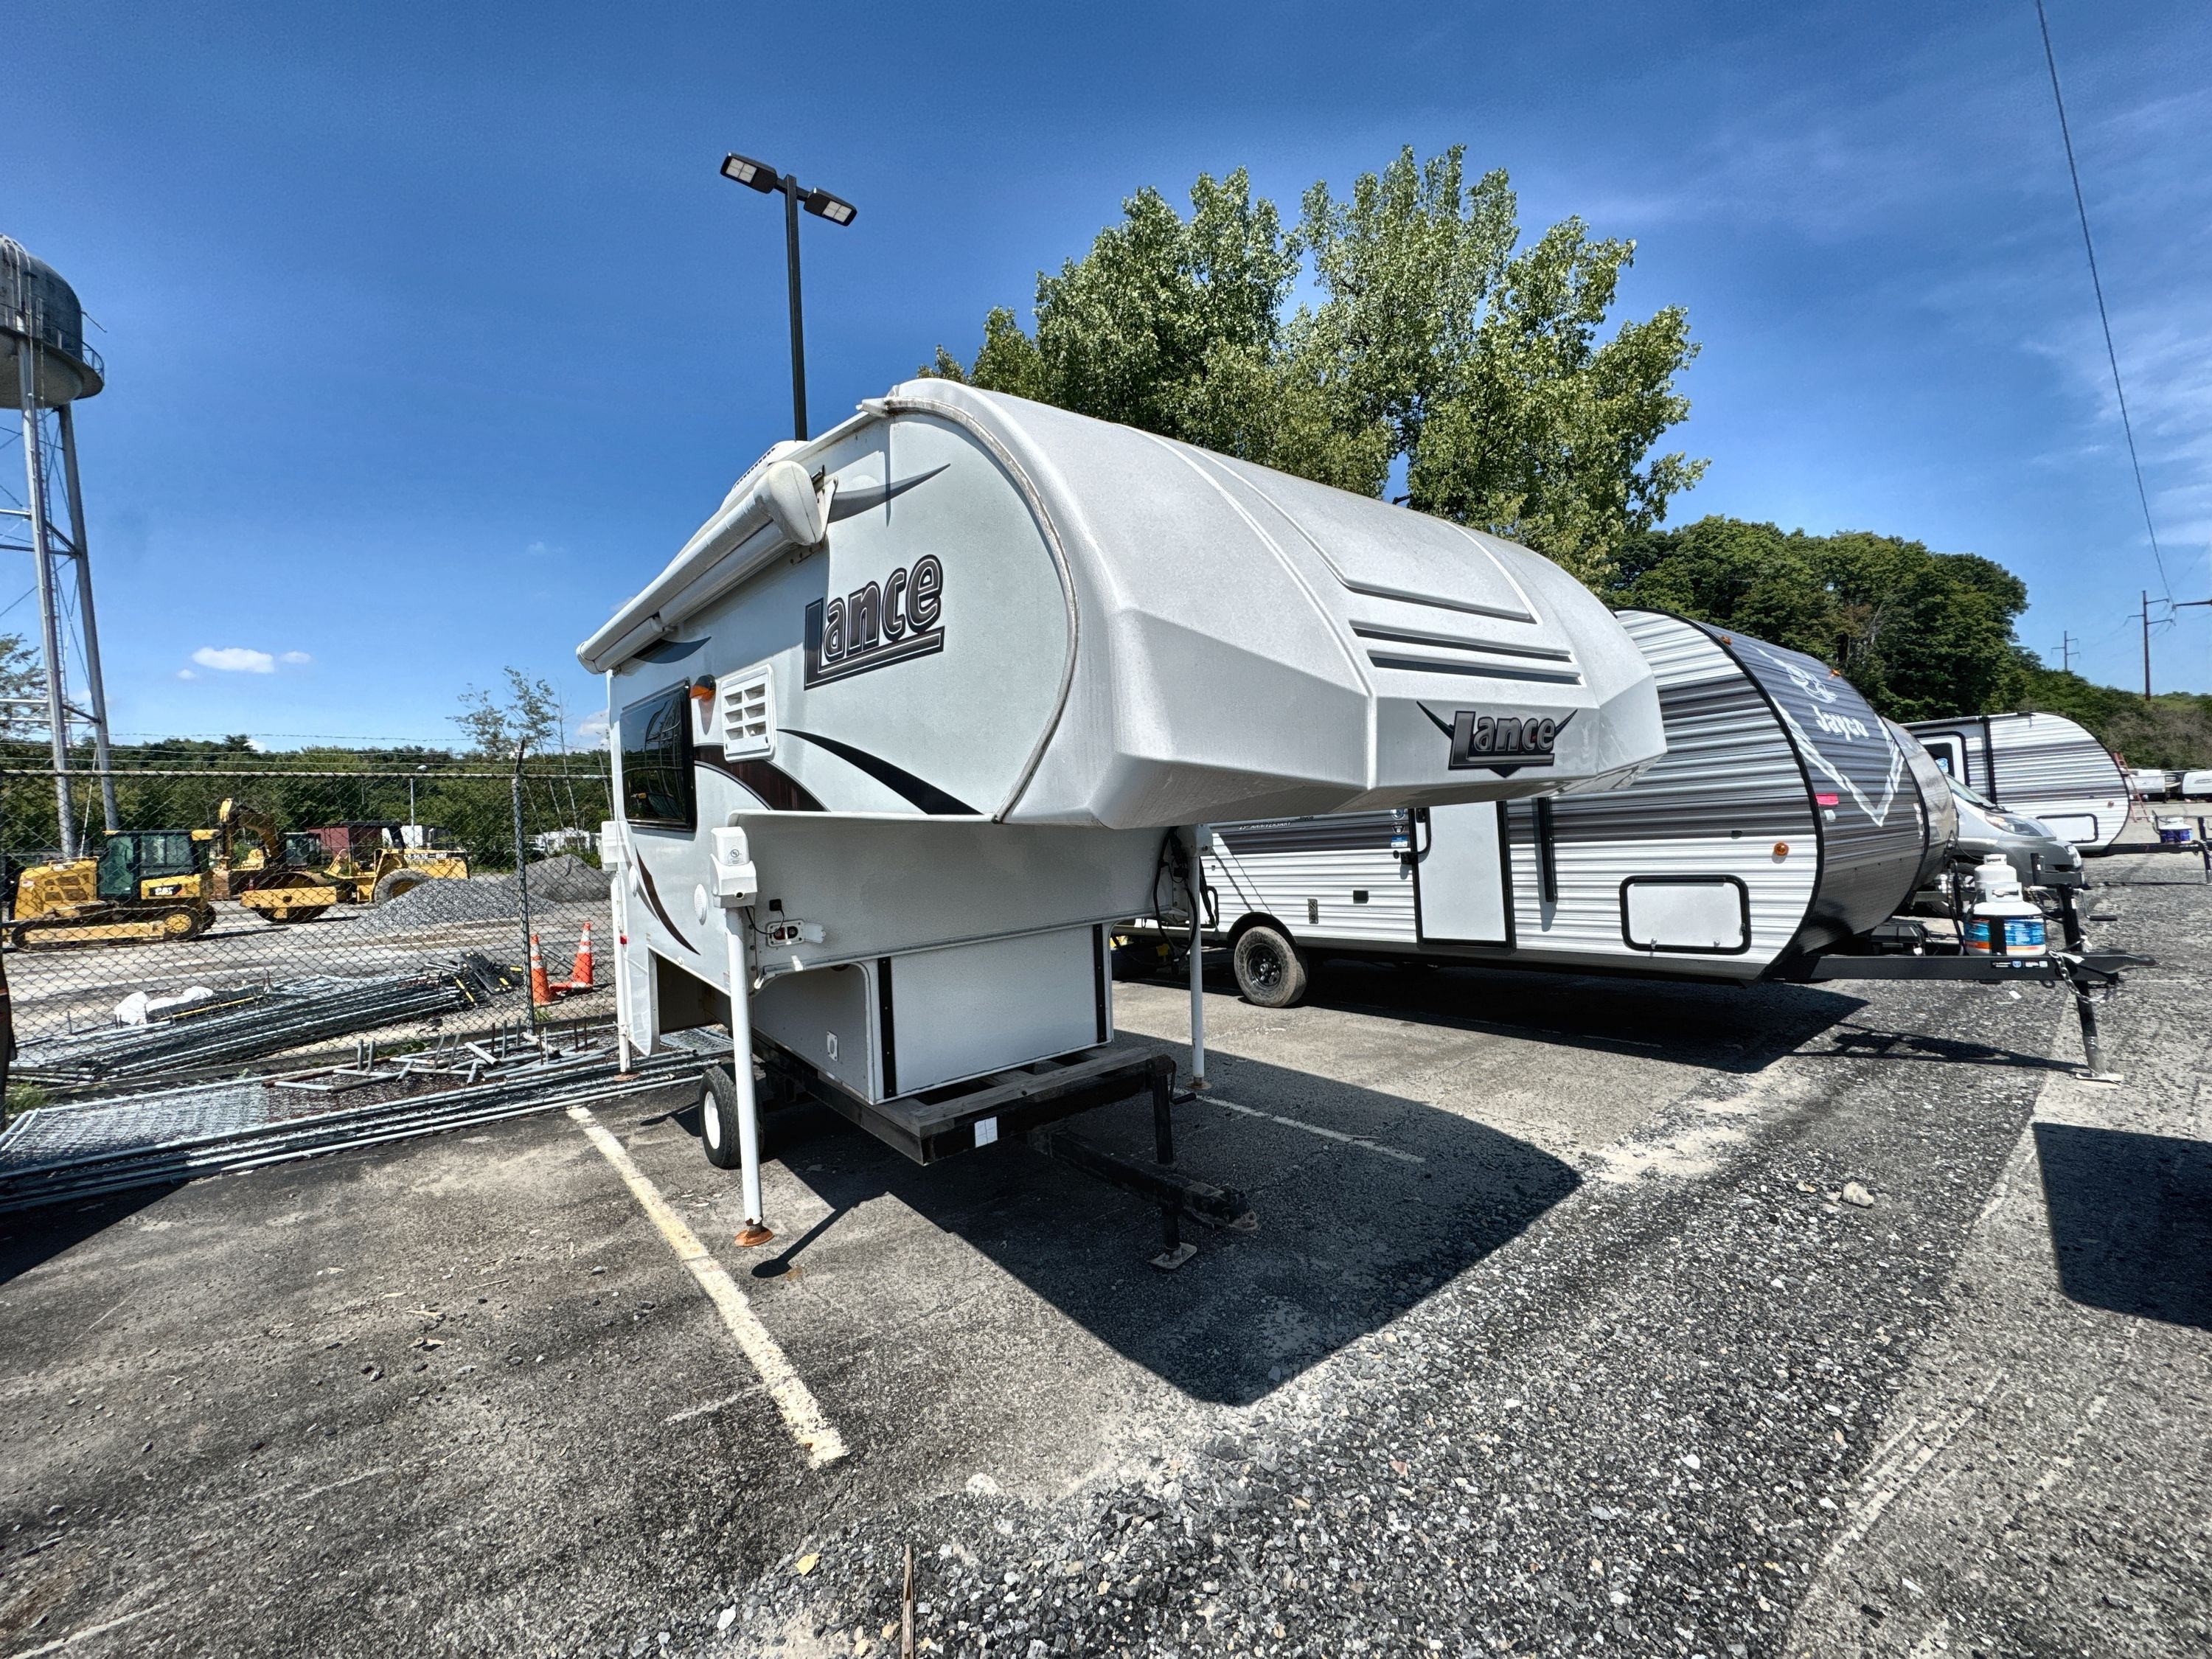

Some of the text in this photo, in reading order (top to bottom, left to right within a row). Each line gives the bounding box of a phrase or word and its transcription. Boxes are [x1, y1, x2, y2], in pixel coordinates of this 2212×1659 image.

[804, 554, 945, 691] Lance
[1448, 710, 1556, 771] Lance
[1808, 703, 1869, 743] Jayco
[155, 887, 174, 896] CAT
